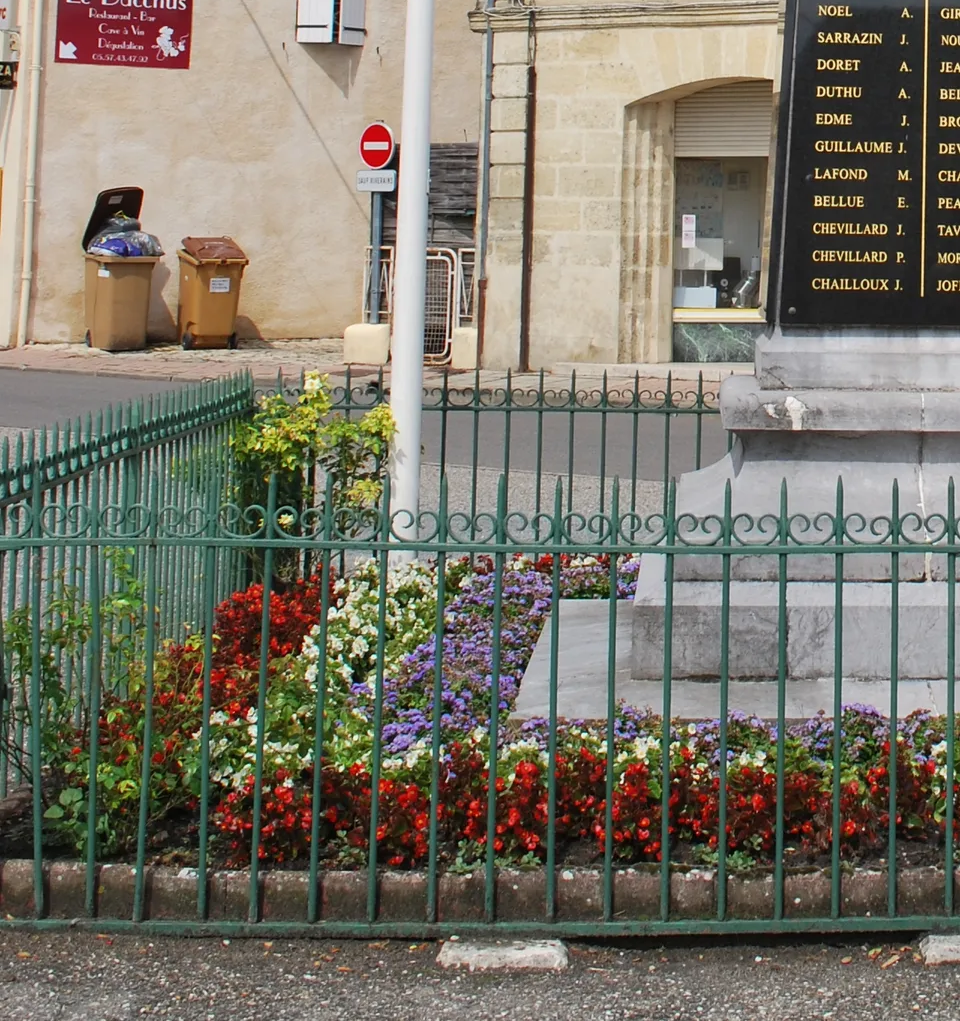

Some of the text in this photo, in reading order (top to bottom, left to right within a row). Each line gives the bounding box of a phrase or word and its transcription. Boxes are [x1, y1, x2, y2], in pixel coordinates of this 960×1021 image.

[89, 8, 131, 20] Restaurant
[140, 11, 156, 22] Bar
[818, 6, 914, 20] NOEL A.
[98, 23, 120, 34] Cave
[131, 25, 144, 36] Vin
[817, 32, 909, 46] SARRAZIN J.
[816, 58, 912, 73] DORET A.
[815, 86, 910, 100] DUTHU A.
[815, 113, 910, 127] EDME J.
[814, 140, 907, 155] GUILLAUME J.
[814, 168, 912, 182] LAFOND M.
[813, 195, 909, 209] BELLUE E.
[812, 222, 905, 237] CHEVILLARD J.
[812, 250, 906, 264] CHEVILLARD P.
[811, 278, 903, 292] CHAILLOUX J.
